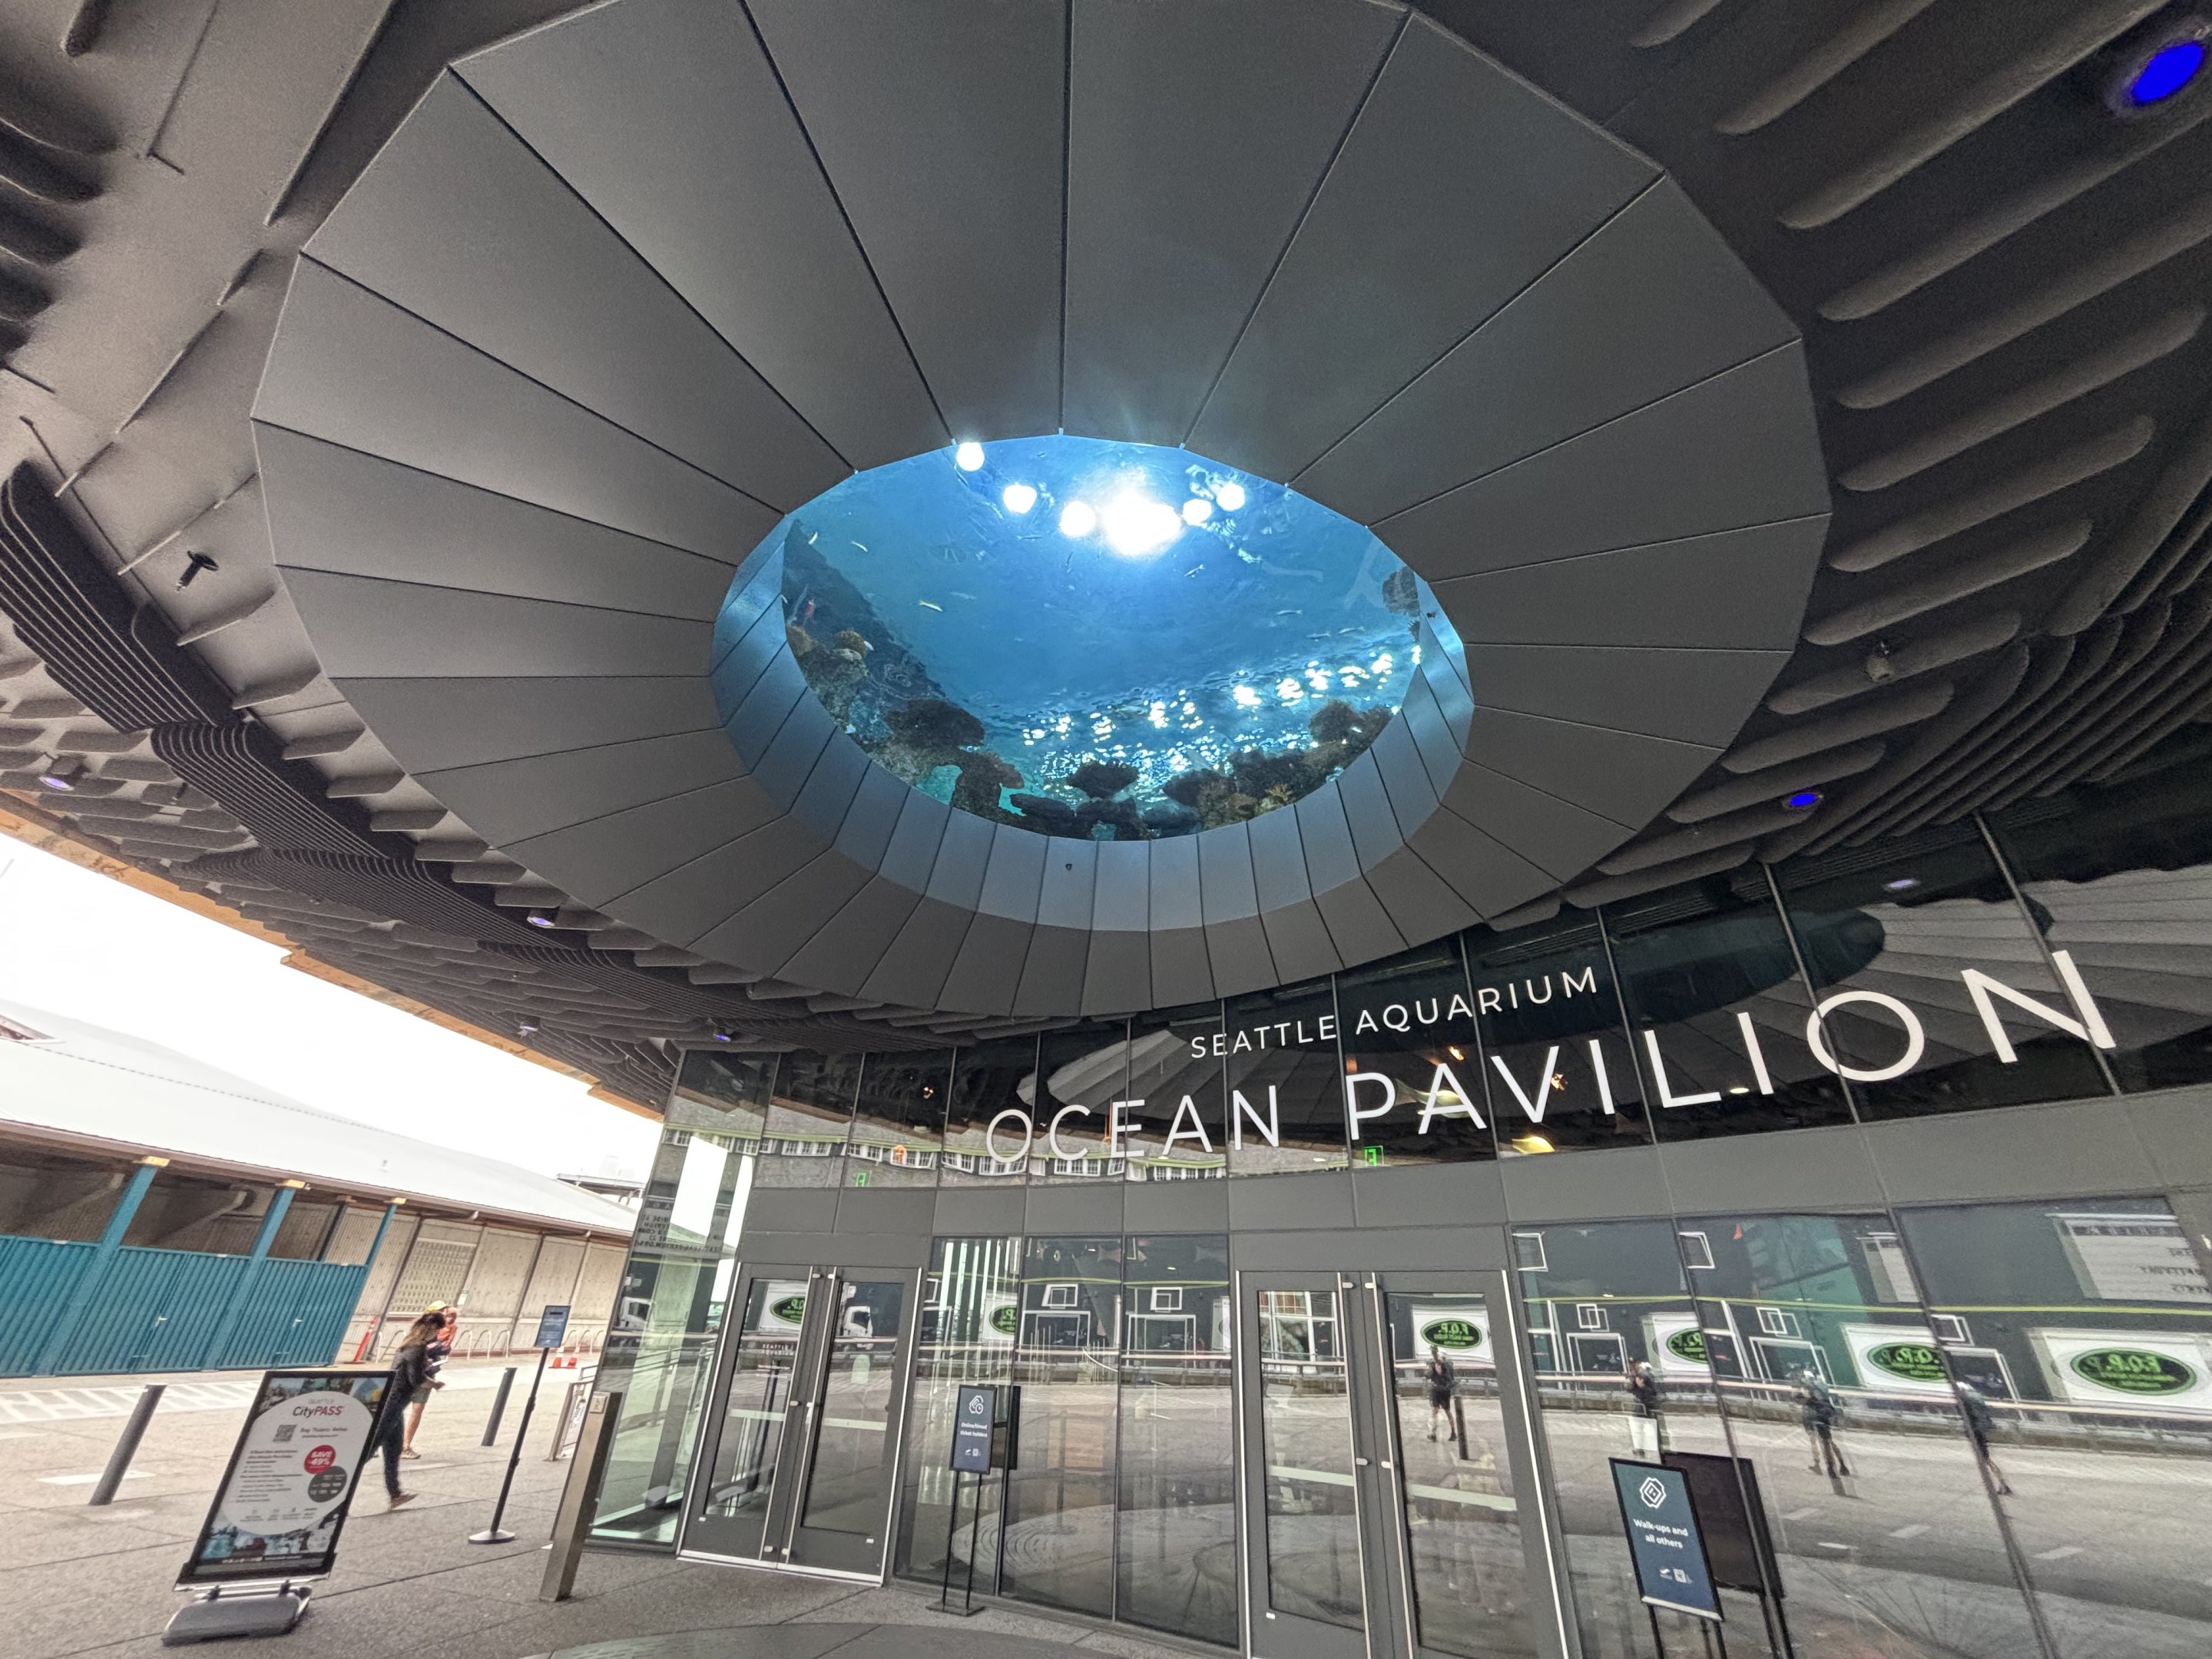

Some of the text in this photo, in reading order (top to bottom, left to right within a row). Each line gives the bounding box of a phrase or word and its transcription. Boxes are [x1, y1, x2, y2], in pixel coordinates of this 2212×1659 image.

[1190, 965, 1598, 1059] SEATTLE AQUARIUM
[985, 949, 2117, 1164] OCEAN PAVILION
[762, 1343, 790, 1352] SEATTLE
[293, 1406, 344, 1418] CityPASS
[1633, 1518, 1689, 1537] Walk-ups and
[1645, 1535, 1684, 1549] all others
